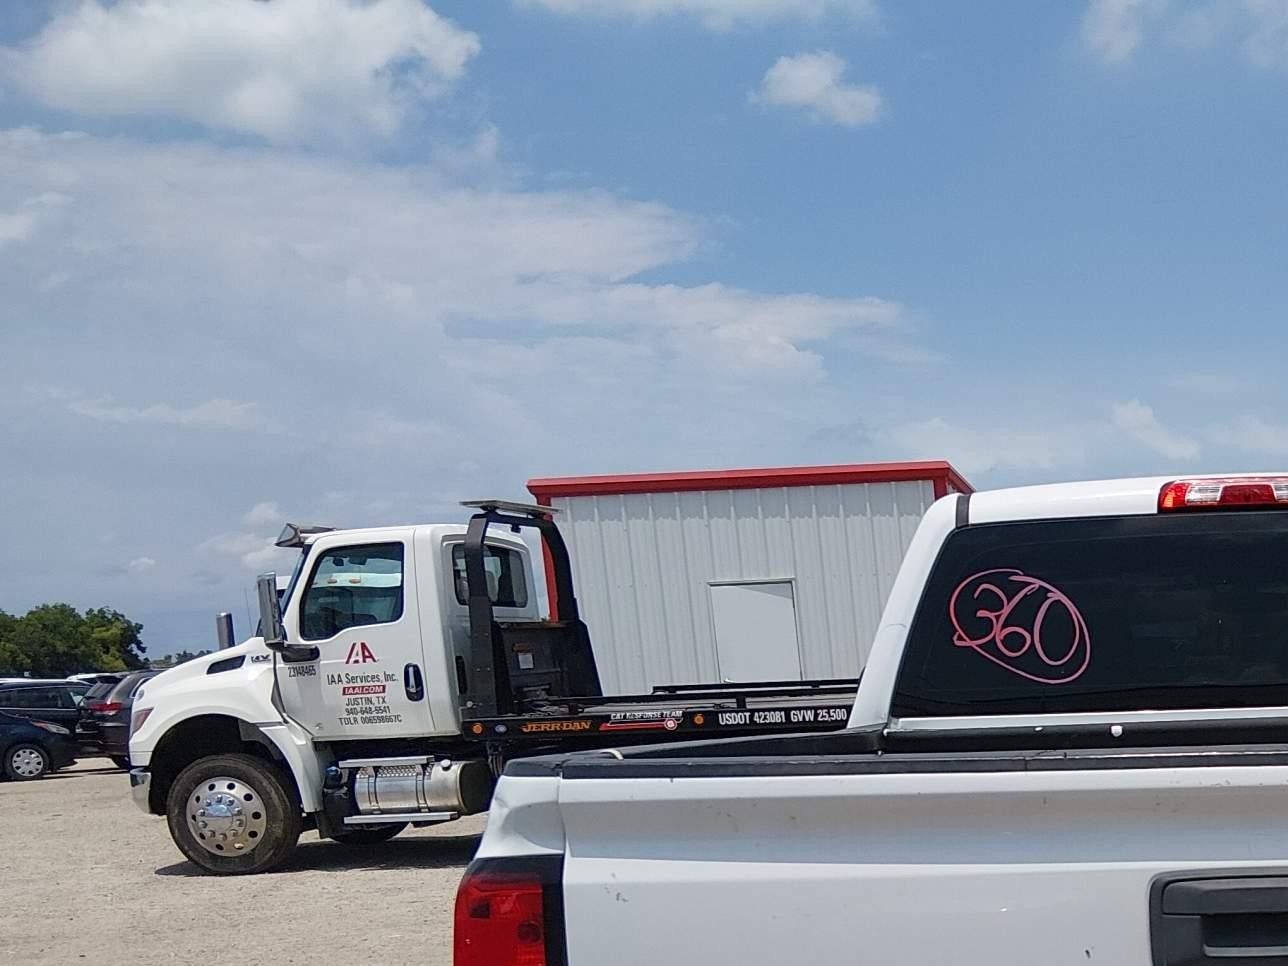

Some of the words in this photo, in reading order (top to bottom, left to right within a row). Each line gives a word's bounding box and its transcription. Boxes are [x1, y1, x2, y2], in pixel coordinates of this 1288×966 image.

[953, 574, 1080, 667] 360
[327, 674, 343, 685] IAA
[345, 672, 383, 684] Services,
[384, 671, 399, 682] Inc.
[346, 697, 375, 706] JUSTIN,
[375, 696, 387, 705] TX
[337, 717, 359, 726] TDLR
[718, 712, 750, 725] USDOT
[753, 711, 786, 723] 423081
[790, 709, 815, 722] GVW
[817, 708, 847, 722] 25,500
